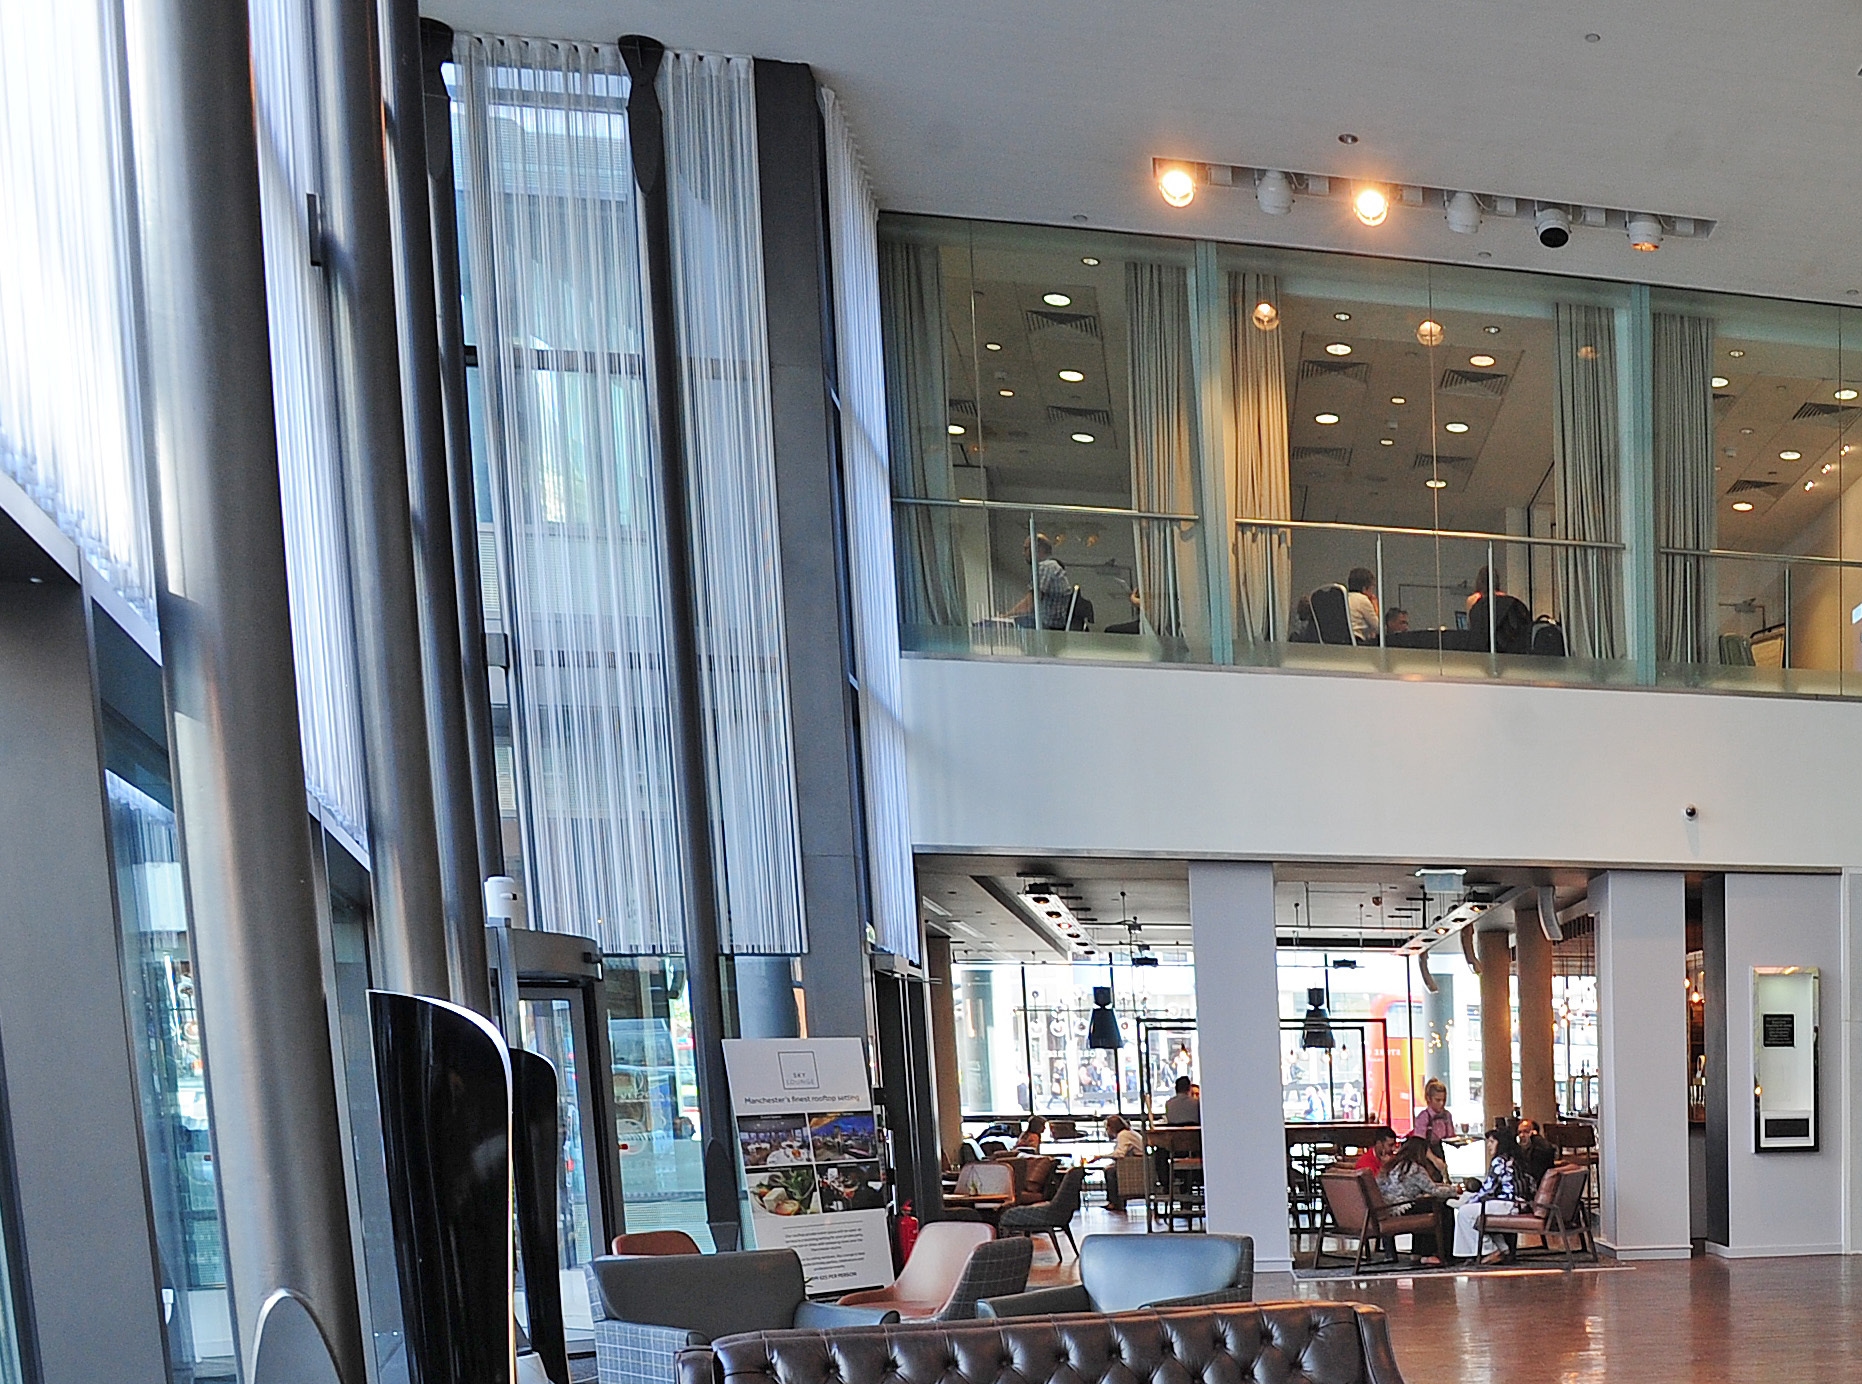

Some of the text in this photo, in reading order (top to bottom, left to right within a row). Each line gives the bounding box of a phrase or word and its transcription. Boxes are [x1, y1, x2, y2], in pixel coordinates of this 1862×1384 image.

[744, 1096, 791, 1105] Manchester's
[791, 1095, 811, 1103] finest
[811, 1095, 837, 1103] rooftop
